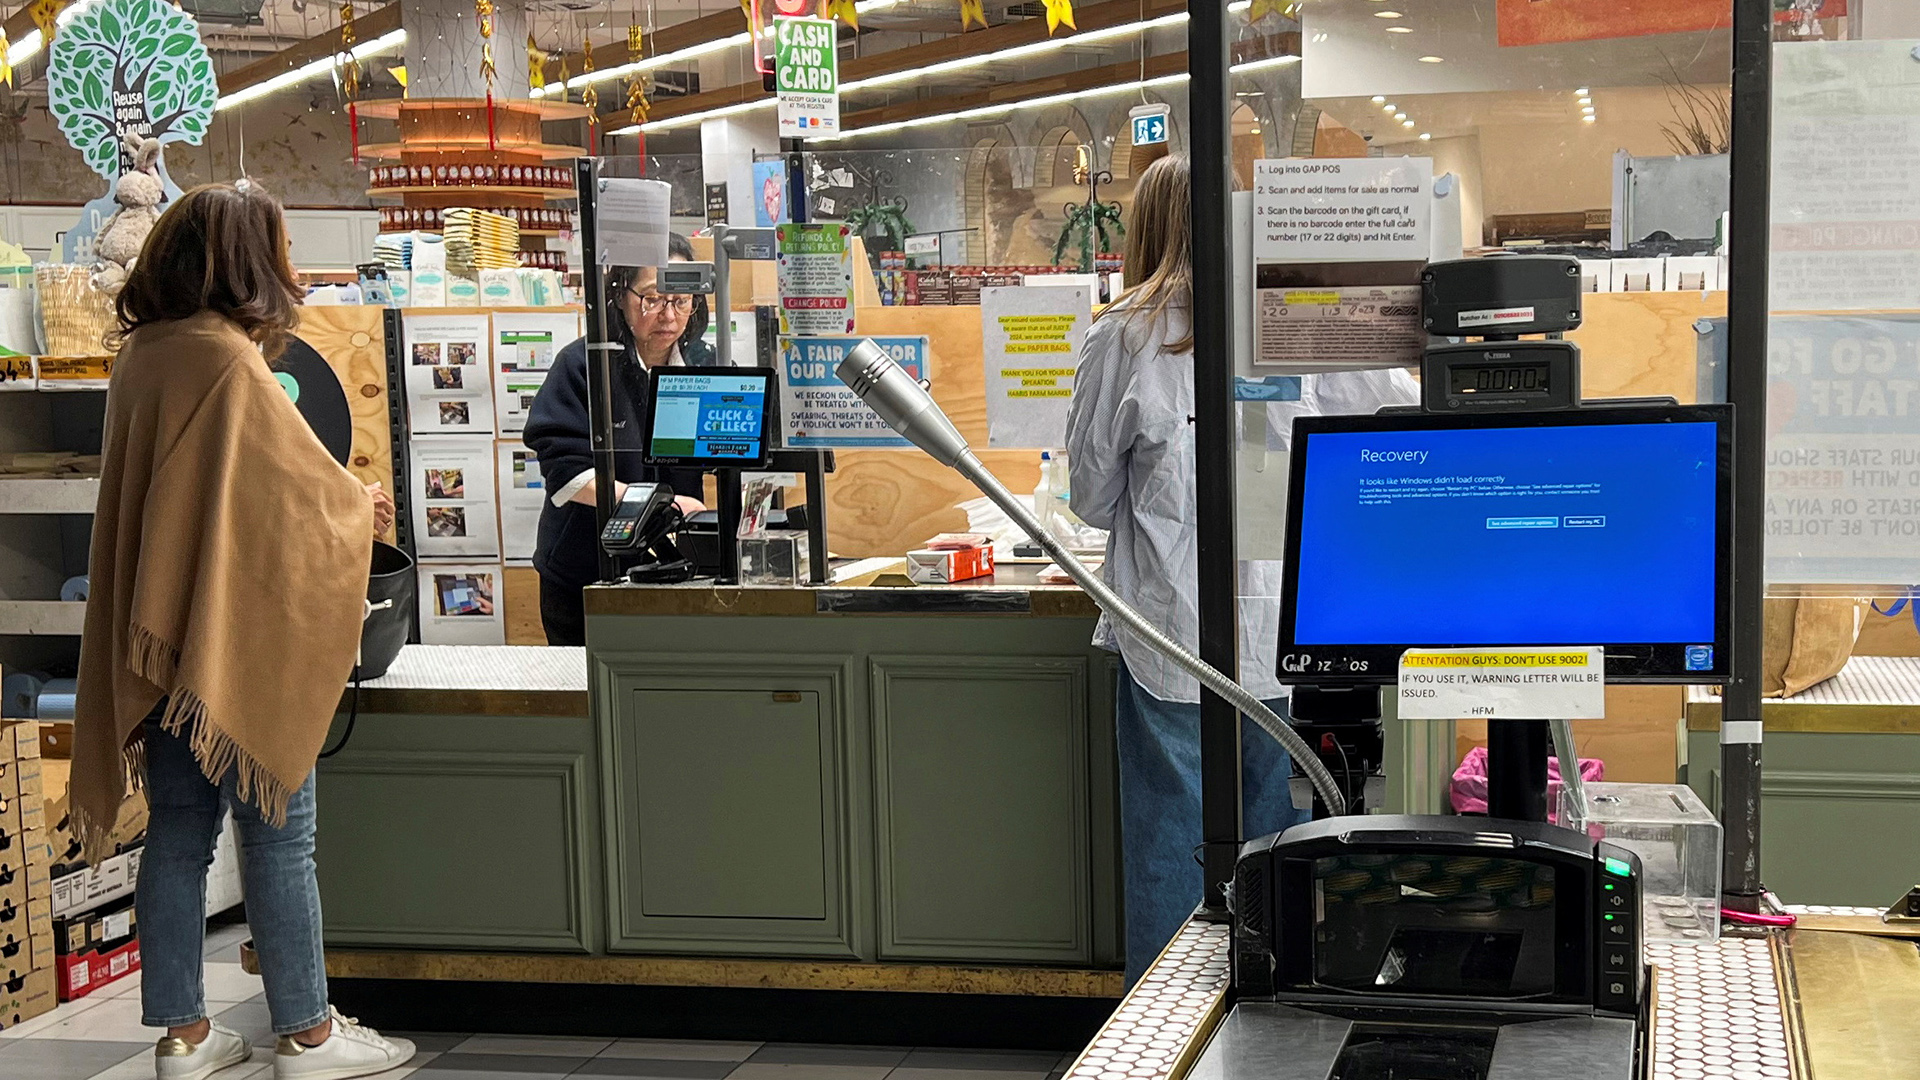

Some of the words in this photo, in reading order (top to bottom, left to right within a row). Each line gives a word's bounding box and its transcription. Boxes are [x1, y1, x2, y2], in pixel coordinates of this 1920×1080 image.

[779, 24, 829, 48] CASH
[790, 47, 822, 66] AND
[780, 66, 832, 90] CARD
[113, 91, 143, 106] Reuse
[116, 106, 142, 122] again
[115, 122, 125, 137] &
[126, 121, 152, 134] again
[1258, 166, 1264, 174] 1.
[1269, 166, 1284, 175] Log
[1285, 165, 1300, 174] into
[1302, 166, 1321, 174] GAP
[1322, 165, 1341, 174] POS
[1258, 186, 1265, 194] 2.
[1268, 186, 1289, 194] Scan
[1290, 186, 1306, 194] and
[1307, 186, 1323, 194] add
[1324, 186, 1347, 194] items
[1348, 185, 1359, 194] for
[1361, 186, 1378, 194] sale
[1390, 185, 1419, 193] normal
[1257, 207, 1264, 215] 3.
[1267, 207, 1288, 215] Scan
[1289, 206, 1303, 215] the
[1304, 206, 1337, 215] barcode
[1351, 206, 1365, 215] the
[1366, 206, 1380, 216] gift
[1403, 206, 1409, 214] if
[1267, 220, 1288, 228] there
[1289, 220, 1297, 228] is
[1310, 219, 1343, 228] barcode
[1345, 220, 1366, 228] enter
[1367, 219, 1382, 227] the
[1383, 219, 1395, 227] full
[1397, 218, 1416, 227] card
[793, 231, 823, 242] REFUNDS
[825, 232, 833, 241] &
[1267, 233, 1298, 242] number
[1299, 232, 1312, 242] (17
[1323, 233, 1335, 241] 22
[1336, 232, 1362, 243] digits)
[1363, 233, 1379, 241] and
[1380, 232, 1391, 241] hit
[1392, 233, 1416, 241] Enter.
[785, 242, 816, 251] RETURNS
[817, 242, 841, 251] POLICY
[788, 299, 818, 308] CHANGE
[819, 299, 843, 307] POLICY
[790, 345, 802, 361] A
[807, 344, 844, 362] FAIR
[883, 344, 916, 361] FOR
[790, 363, 826, 379] OUR
[806, 392, 837, 400] RECKON
[838, 392, 854, 400] OUR
[804, 400, 813, 408] BE
[815, 400, 847, 408] TREATED
[708, 409, 742, 421] CLICK
[745, 409, 755, 421] &
[791, 412, 829, 421] SWEARING,
[831, 412, 864, 420] THREATS
[802, 420, 836, 429] VIOLENCE
[839, 420, 862, 429] WON'T
[1360, 448, 1429, 464] Recovery
[1386, 477, 1399, 485] like
[1400, 477, 1432, 485] Windows
[1434, 476, 1455, 484] didn't
[1456, 476, 1473, 484] load
[1474, 475, 1506, 484] correctly
[1402, 656, 1470, 666] ATTENTATION
[1471, 656, 1500, 665] GUYS:
[1504, 656, 1535, 665] DON'T
[1538, 656, 1556, 665] USE
[1559, 655, 1588, 664] 9002!
[1402, 675, 1410, 683] IF
[1413, 674, 1434, 683] YOU
[1436, 675, 1454, 683] USE
[1457, 674, 1469, 684] IT,
[1471, 674, 1521, 683] WARNING
[1523, 674, 1558, 683] LETTER
[1560, 673, 1585, 682] WILL
[1587, 673, 1599, 682] BE
[1401, 689, 1438, 698] ISSUED.
[1471, 706, 1495, 715] HFM
